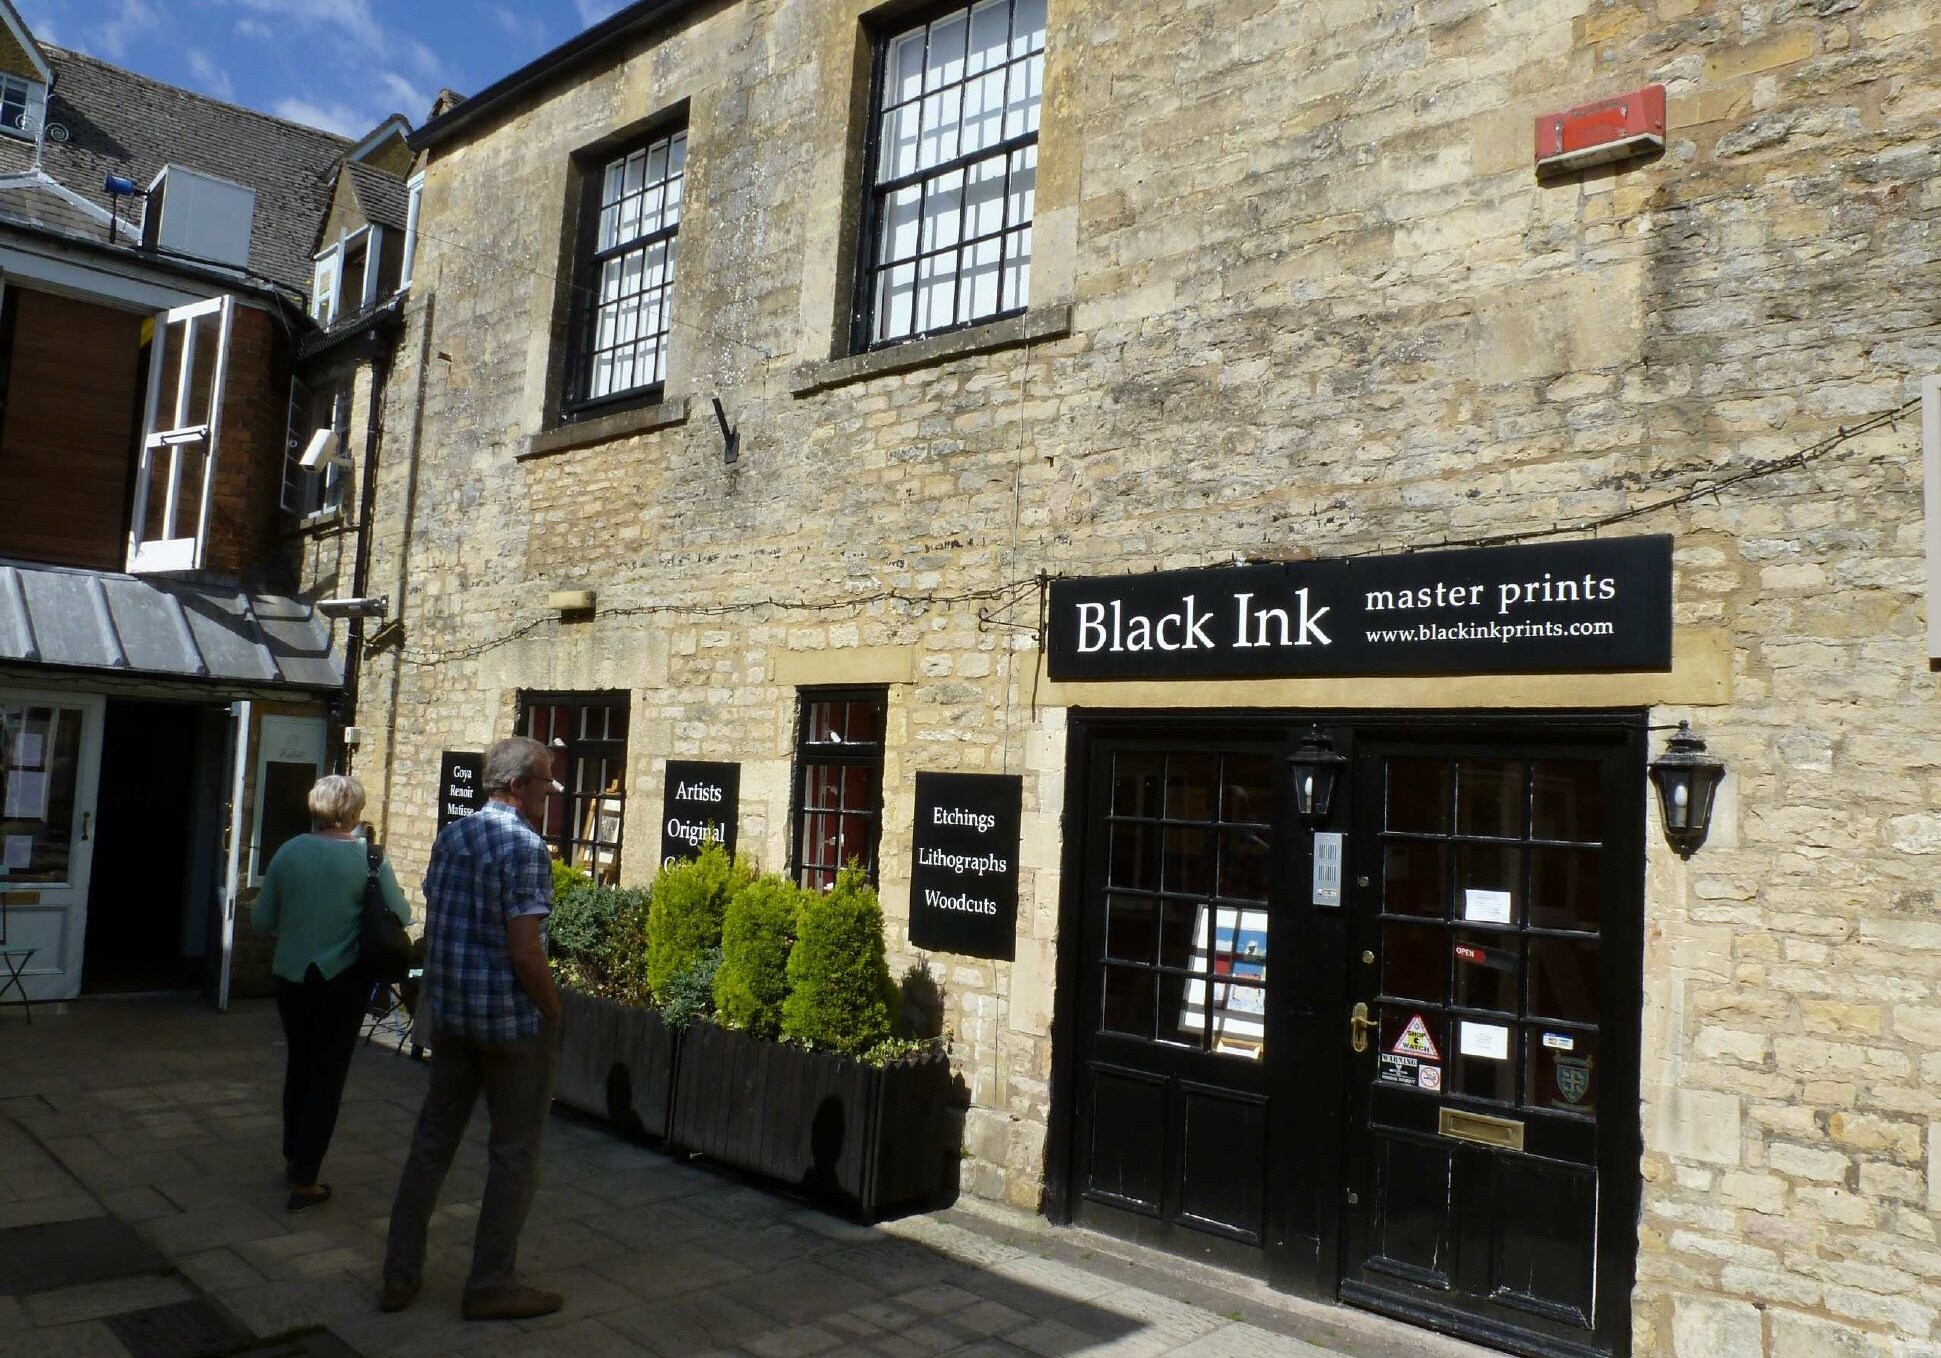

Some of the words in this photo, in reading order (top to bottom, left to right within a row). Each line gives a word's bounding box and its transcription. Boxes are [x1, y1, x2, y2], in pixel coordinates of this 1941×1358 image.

[1365, 582, 1484, 611] master
[1498, 573, 1616, 615] prints
[1076, 595, 1215, 653] Black
[1233, 588, 1333, 647] Ink
[1365, 619, 1615, 645] www.blackinkprints.com
[453, 765, 473, 782] Goya
[450, 784, 474, 799] Renoir
[675, 780, 722, 803] Artists
[447, 802, 475, 817] Matisse
[933, 806, 996, 833] Etchings
[918, 847, 1008, 877] Lithographs
[925, 889, 998, 915] Woodcuts
[1455, 946, 1475, 958] OPEN
[1407, 1030, 1427, 1039] SHOP
[1402, 1042, 1431, 1053] WATCH
[1382, 1054, 1417, 1067] WARNING
